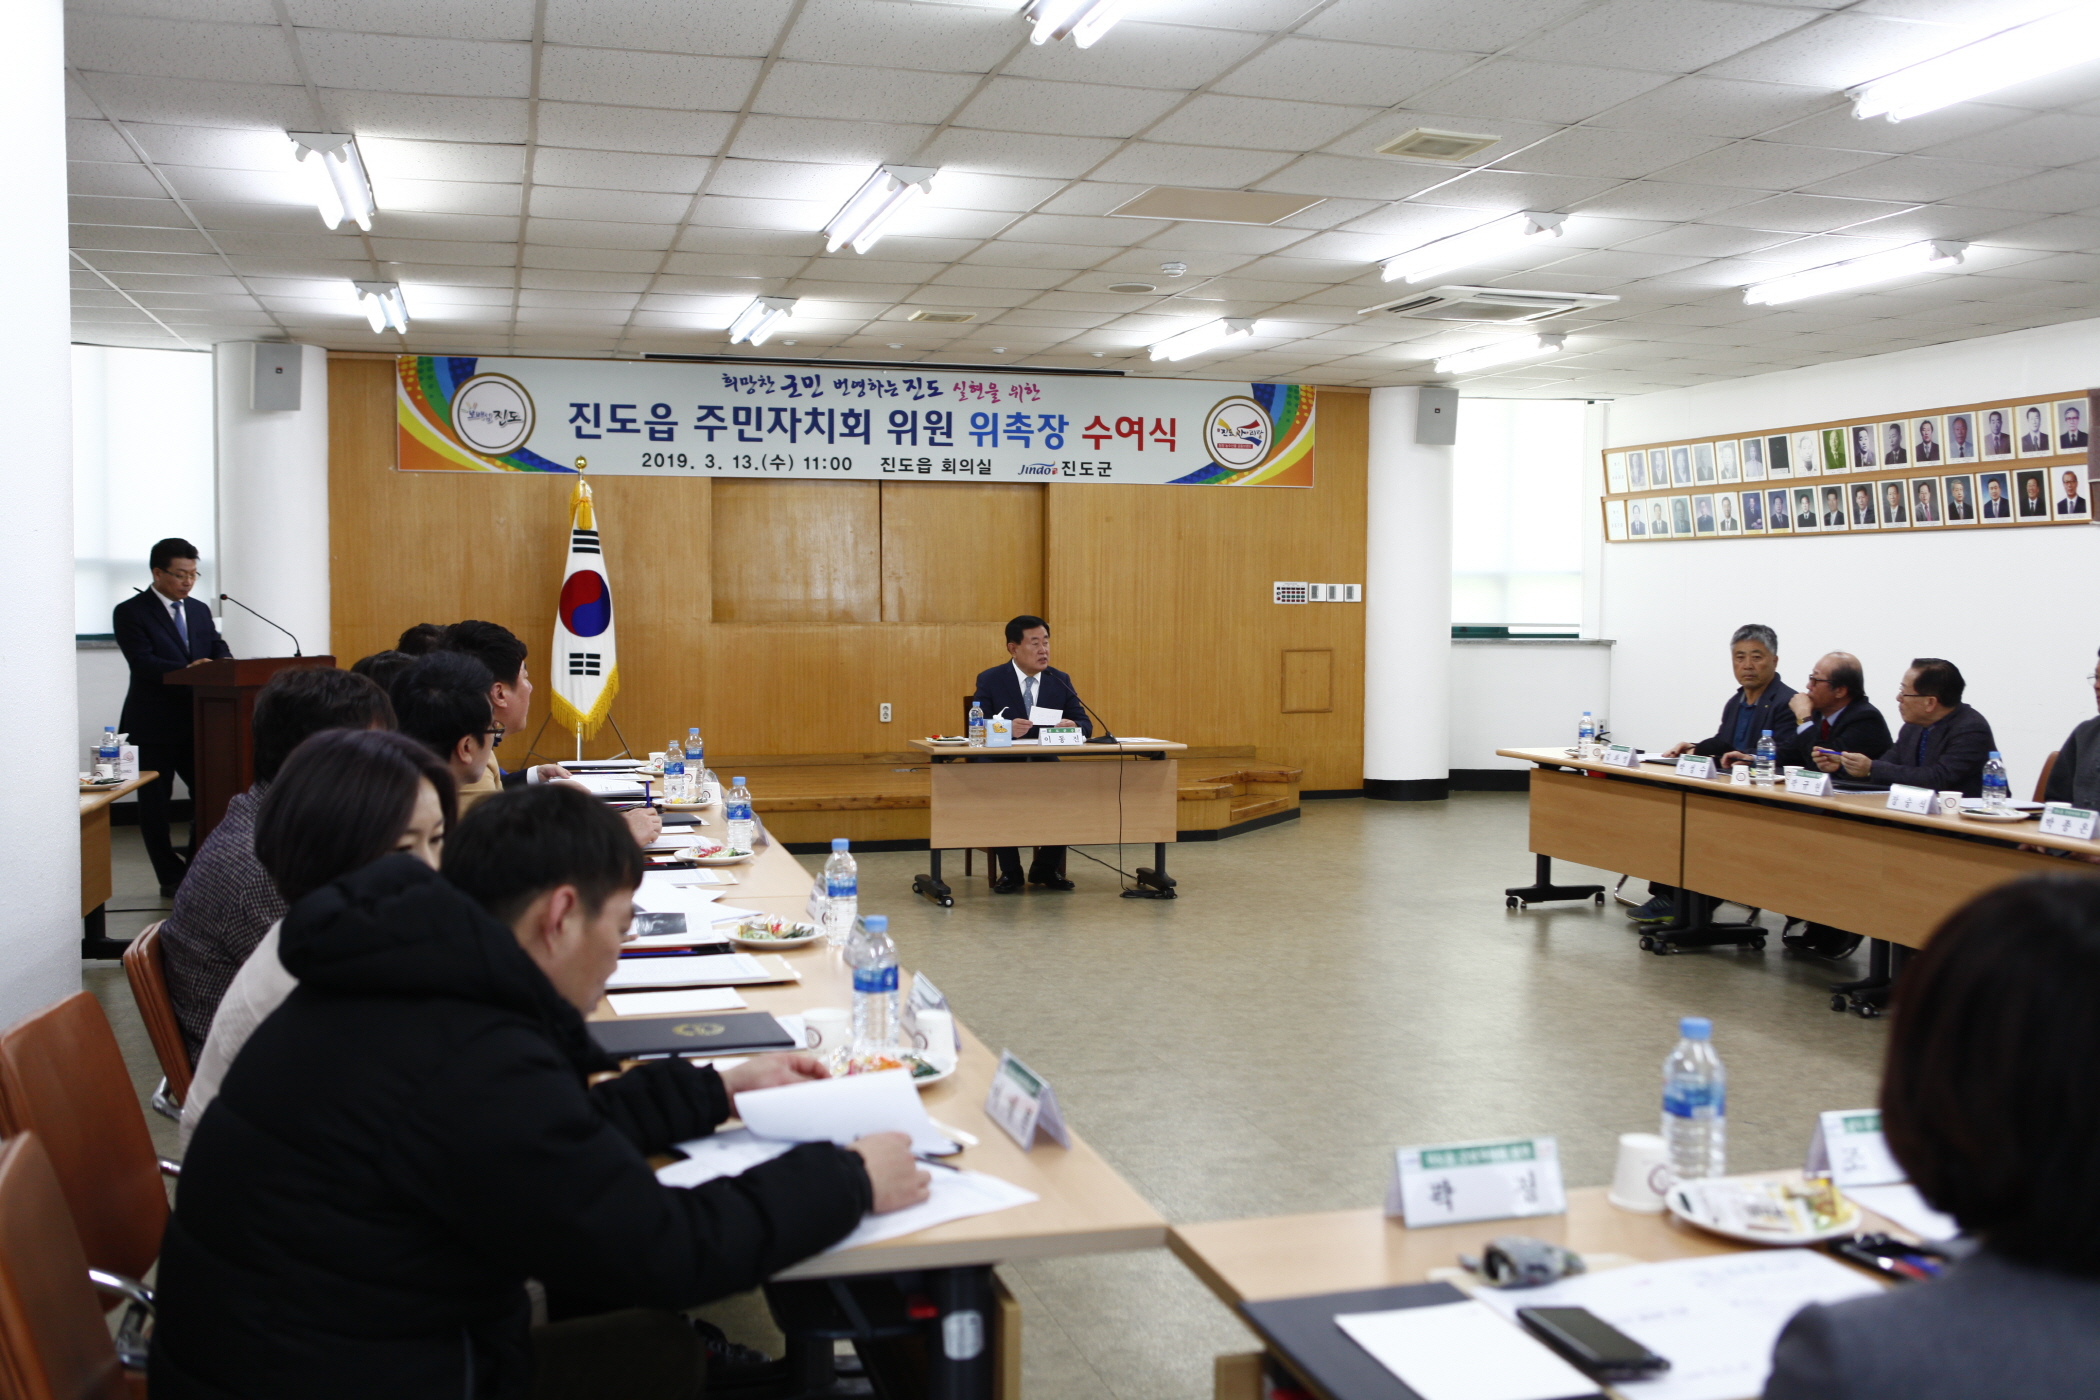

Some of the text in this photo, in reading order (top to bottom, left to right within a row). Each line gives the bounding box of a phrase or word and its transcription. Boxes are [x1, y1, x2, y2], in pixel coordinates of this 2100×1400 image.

[721, 373, 1041, 404] 희망찬 군민 번영하는 진도 실현을 위한
[492, 409, 523, 427] 진도
[568, 402, 1177, 452] 진도읍 주민자치회 위원 위촉장 수여식
[641, 453, 695, 470] 2019.
[704, 454, 723, 470] 3.
[803, 456, 853, 471] 11:00
[880, 457, 992, 476] 진도읍 회의실
[1061, 460, 1113, 478] 진도군
